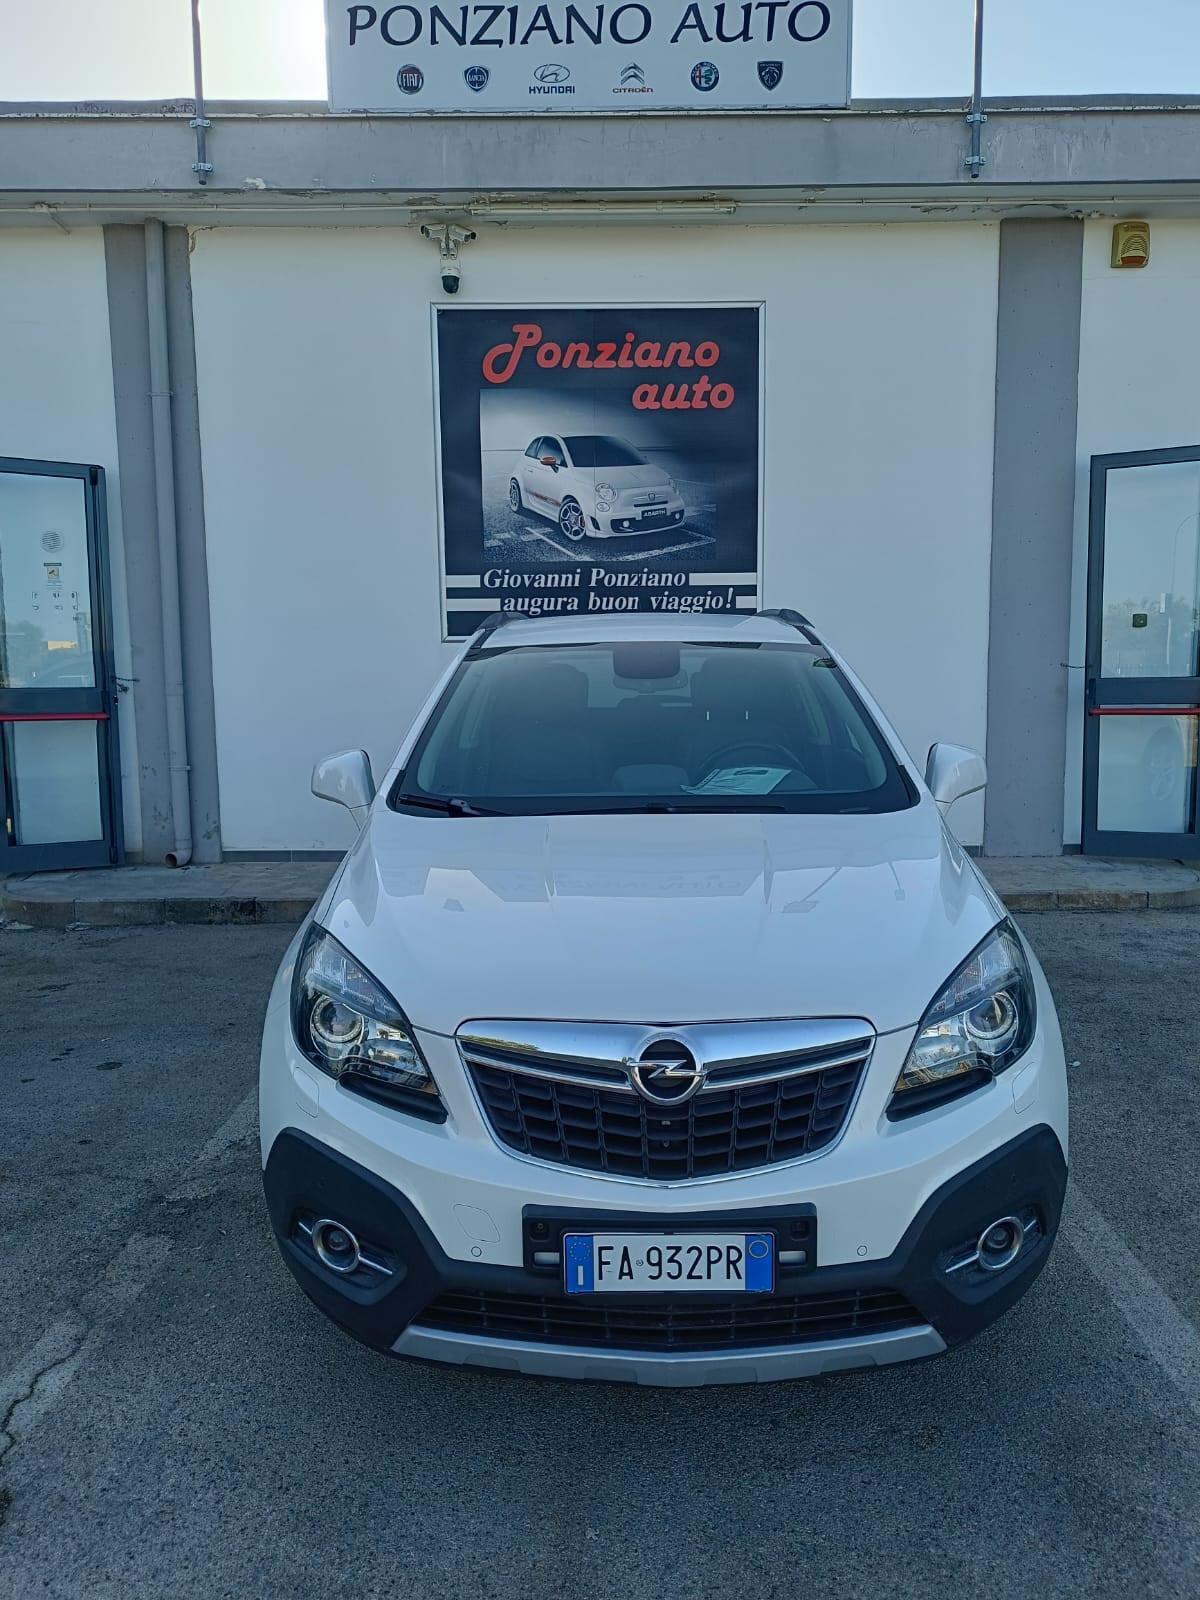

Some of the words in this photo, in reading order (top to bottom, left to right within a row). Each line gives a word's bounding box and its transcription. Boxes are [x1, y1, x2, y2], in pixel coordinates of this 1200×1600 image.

[346, 3, 652, 48] PONZIANO
[670, 0, 831, 43] AUTO
[402, 73, 418, 87] FIAT
[528, 86, 576, 94] HYUNDAI
[482, 323, 720, 384] Ponziano
[632, 375, 735, 410] auto
[483, 568, 581, 588] Giovanni
[588, 567, 687, 587] Ponziano
[503, 596, 579, 615] augura
[588, 591, 640, 610] buon
[650, 588, 734, 614] viaggio!
